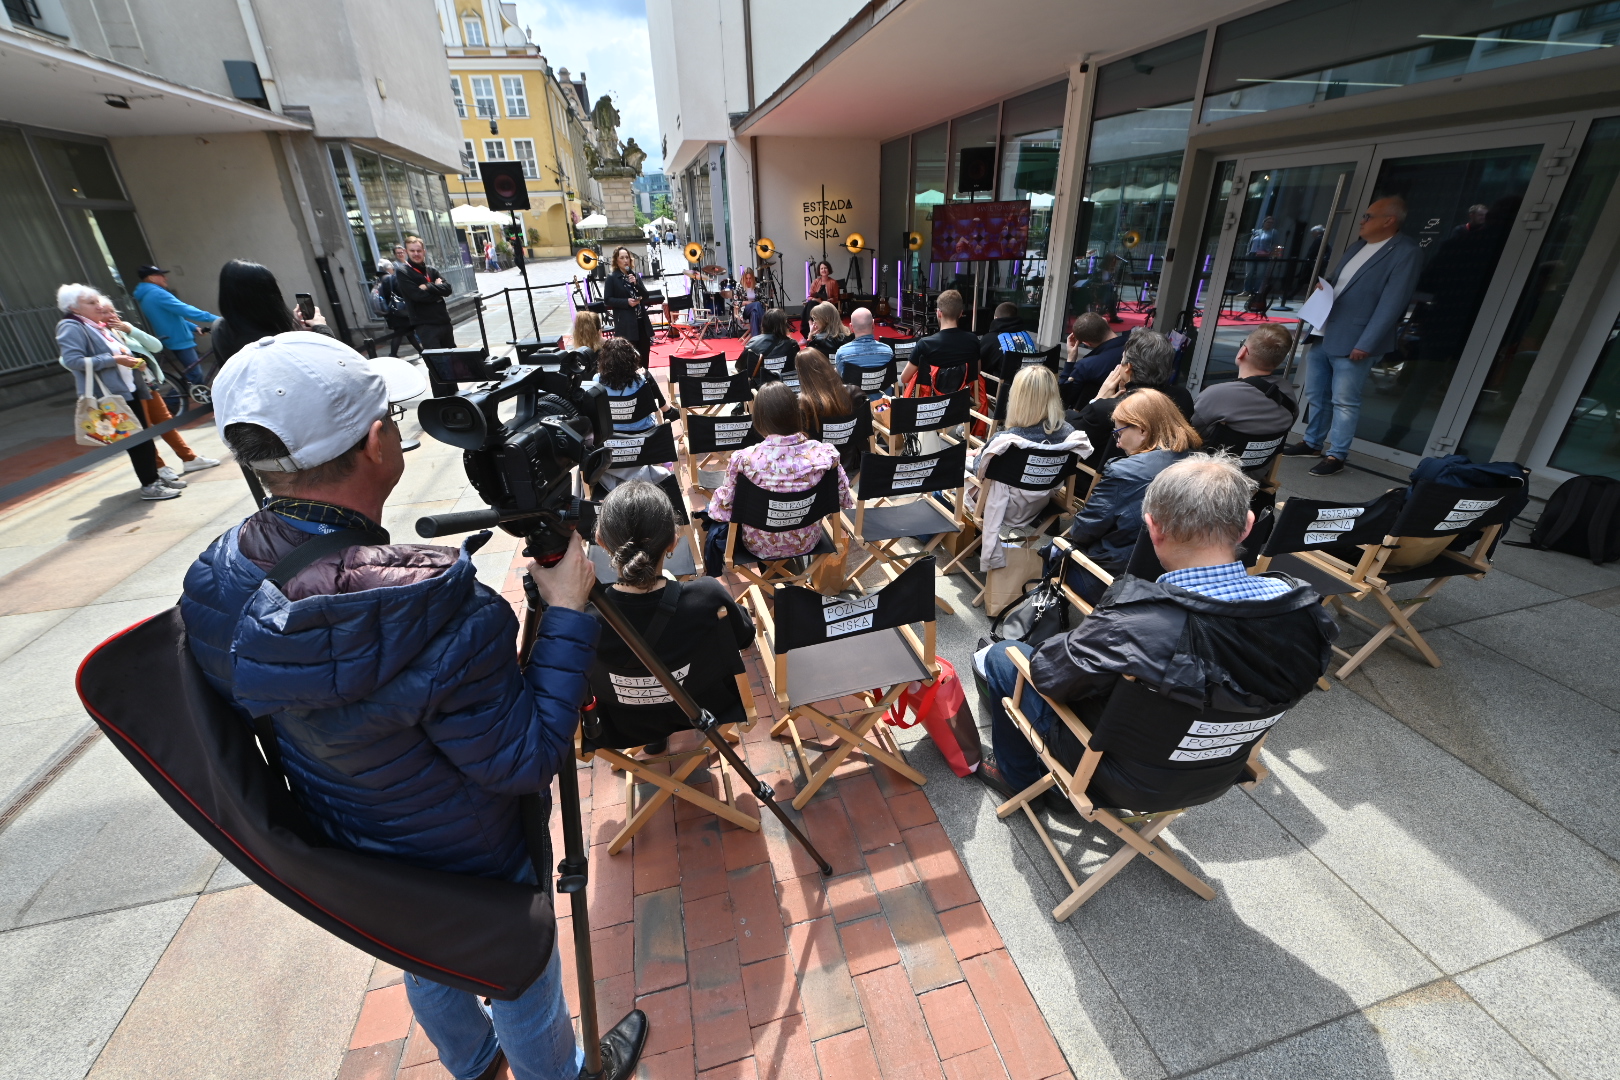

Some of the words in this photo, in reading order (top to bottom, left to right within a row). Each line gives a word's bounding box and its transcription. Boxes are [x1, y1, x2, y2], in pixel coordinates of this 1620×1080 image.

[803, 199, 853, 213] ESTRADA
[804, 213, 847, 227] POZNA
[1030, 455, 1066, 464] ESTRADA
[771, 498, 814, 509] ESTRADA
[1320, 509, 1361, 519] ESTRADA
[827, 599, 876, 619] POZNA
[614, 670, 685, 686] ESTRAA
[618, 687, 669, 697] POZN
[1196, 718, 1275, 734] ESTRADA
[1186, 733, 1255, 747] POZNA
